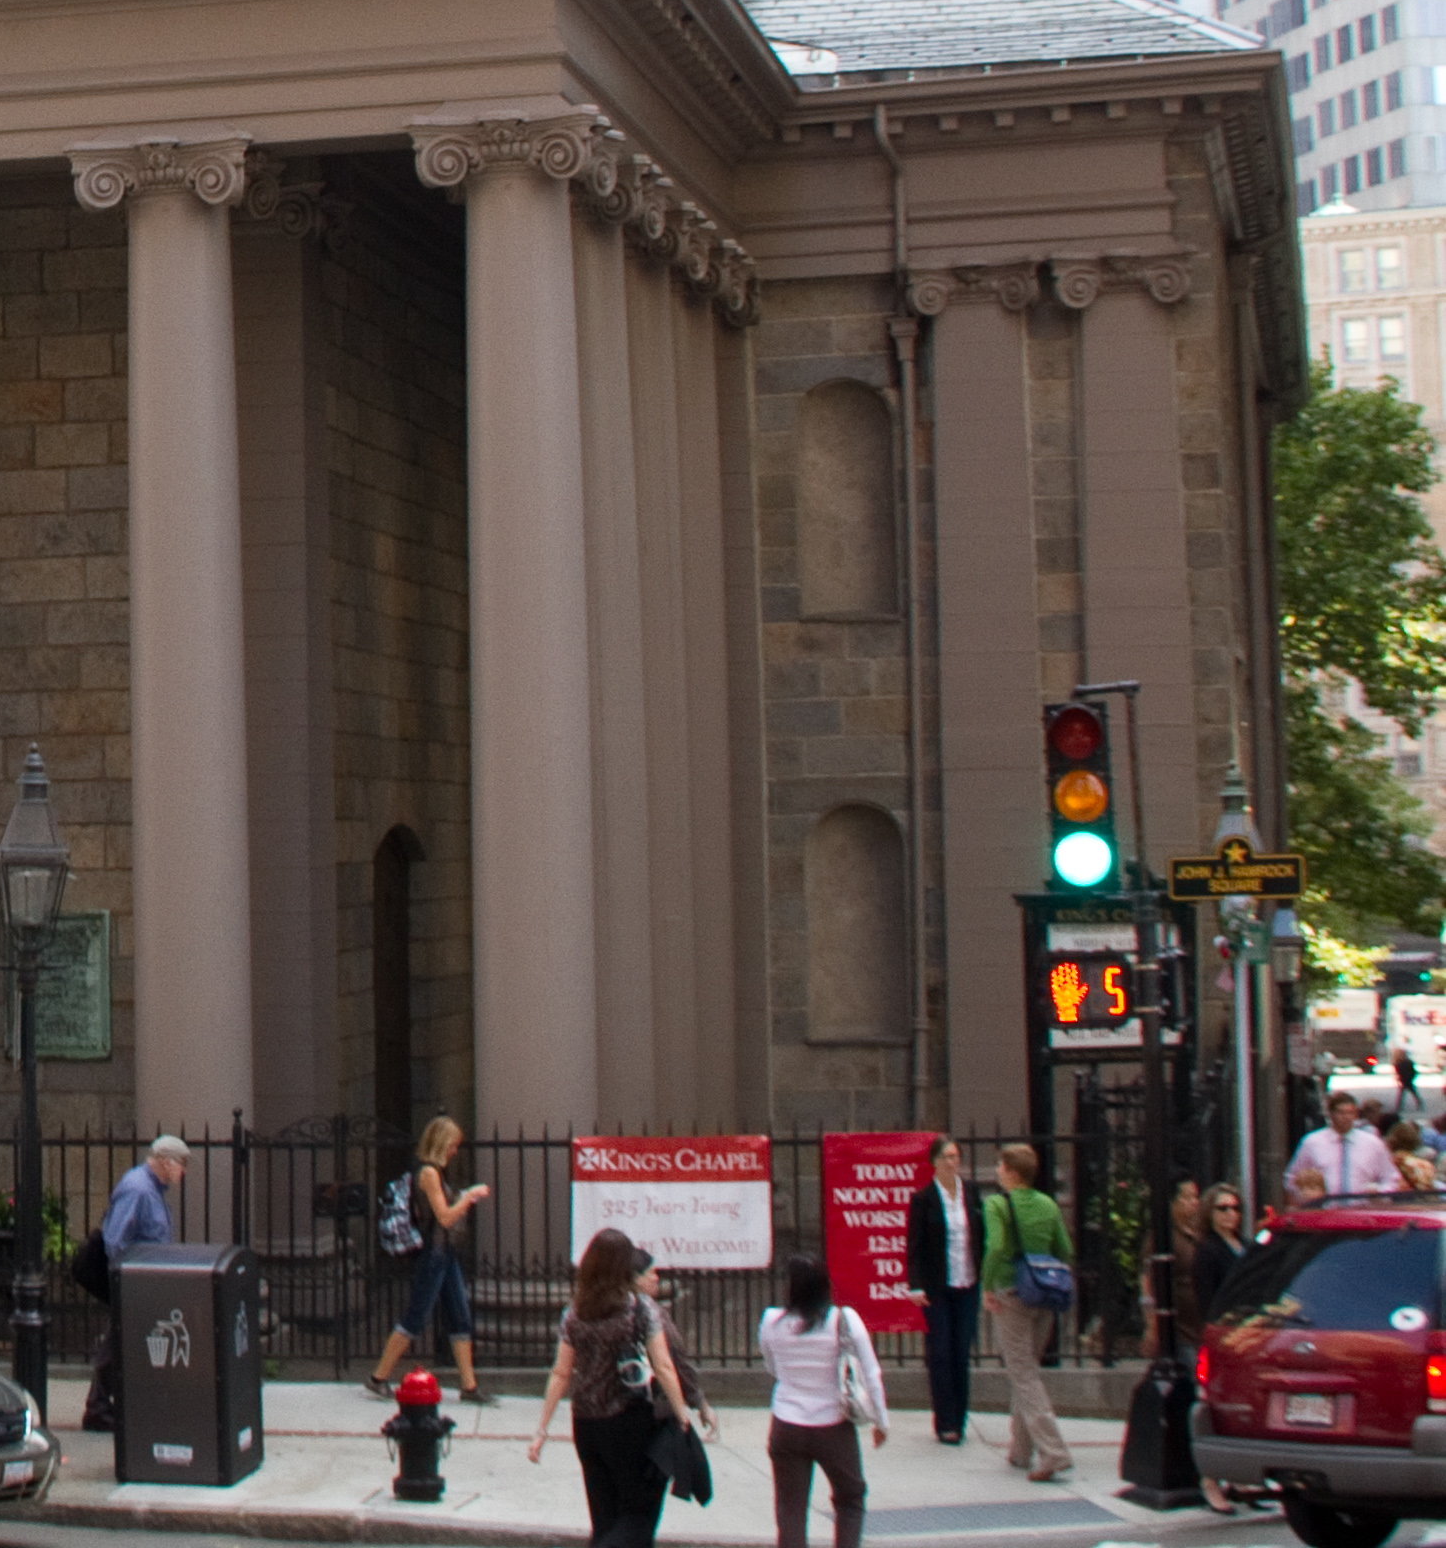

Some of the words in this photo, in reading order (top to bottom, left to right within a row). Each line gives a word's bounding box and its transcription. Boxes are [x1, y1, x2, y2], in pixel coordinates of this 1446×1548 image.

[1176, 865, 1212, 880] JOHN
[1208, 879, 1263, 893] SQUARE
[1103, 965, 1126, 1016] 5
[600, 1148, 671, 1171] KING'S
[674, 1148, 764, 1171] CHAPEL
[852, 1163, 918, 1182] TODAY
[832, 1187, 888, 1205] NOON
[601, 1199, 638, 1219] 325
[645, 1196, 685, 1216] Years
[692, 1196, 742, 1221] Young
[873, 1258, 904, 1277] TO
